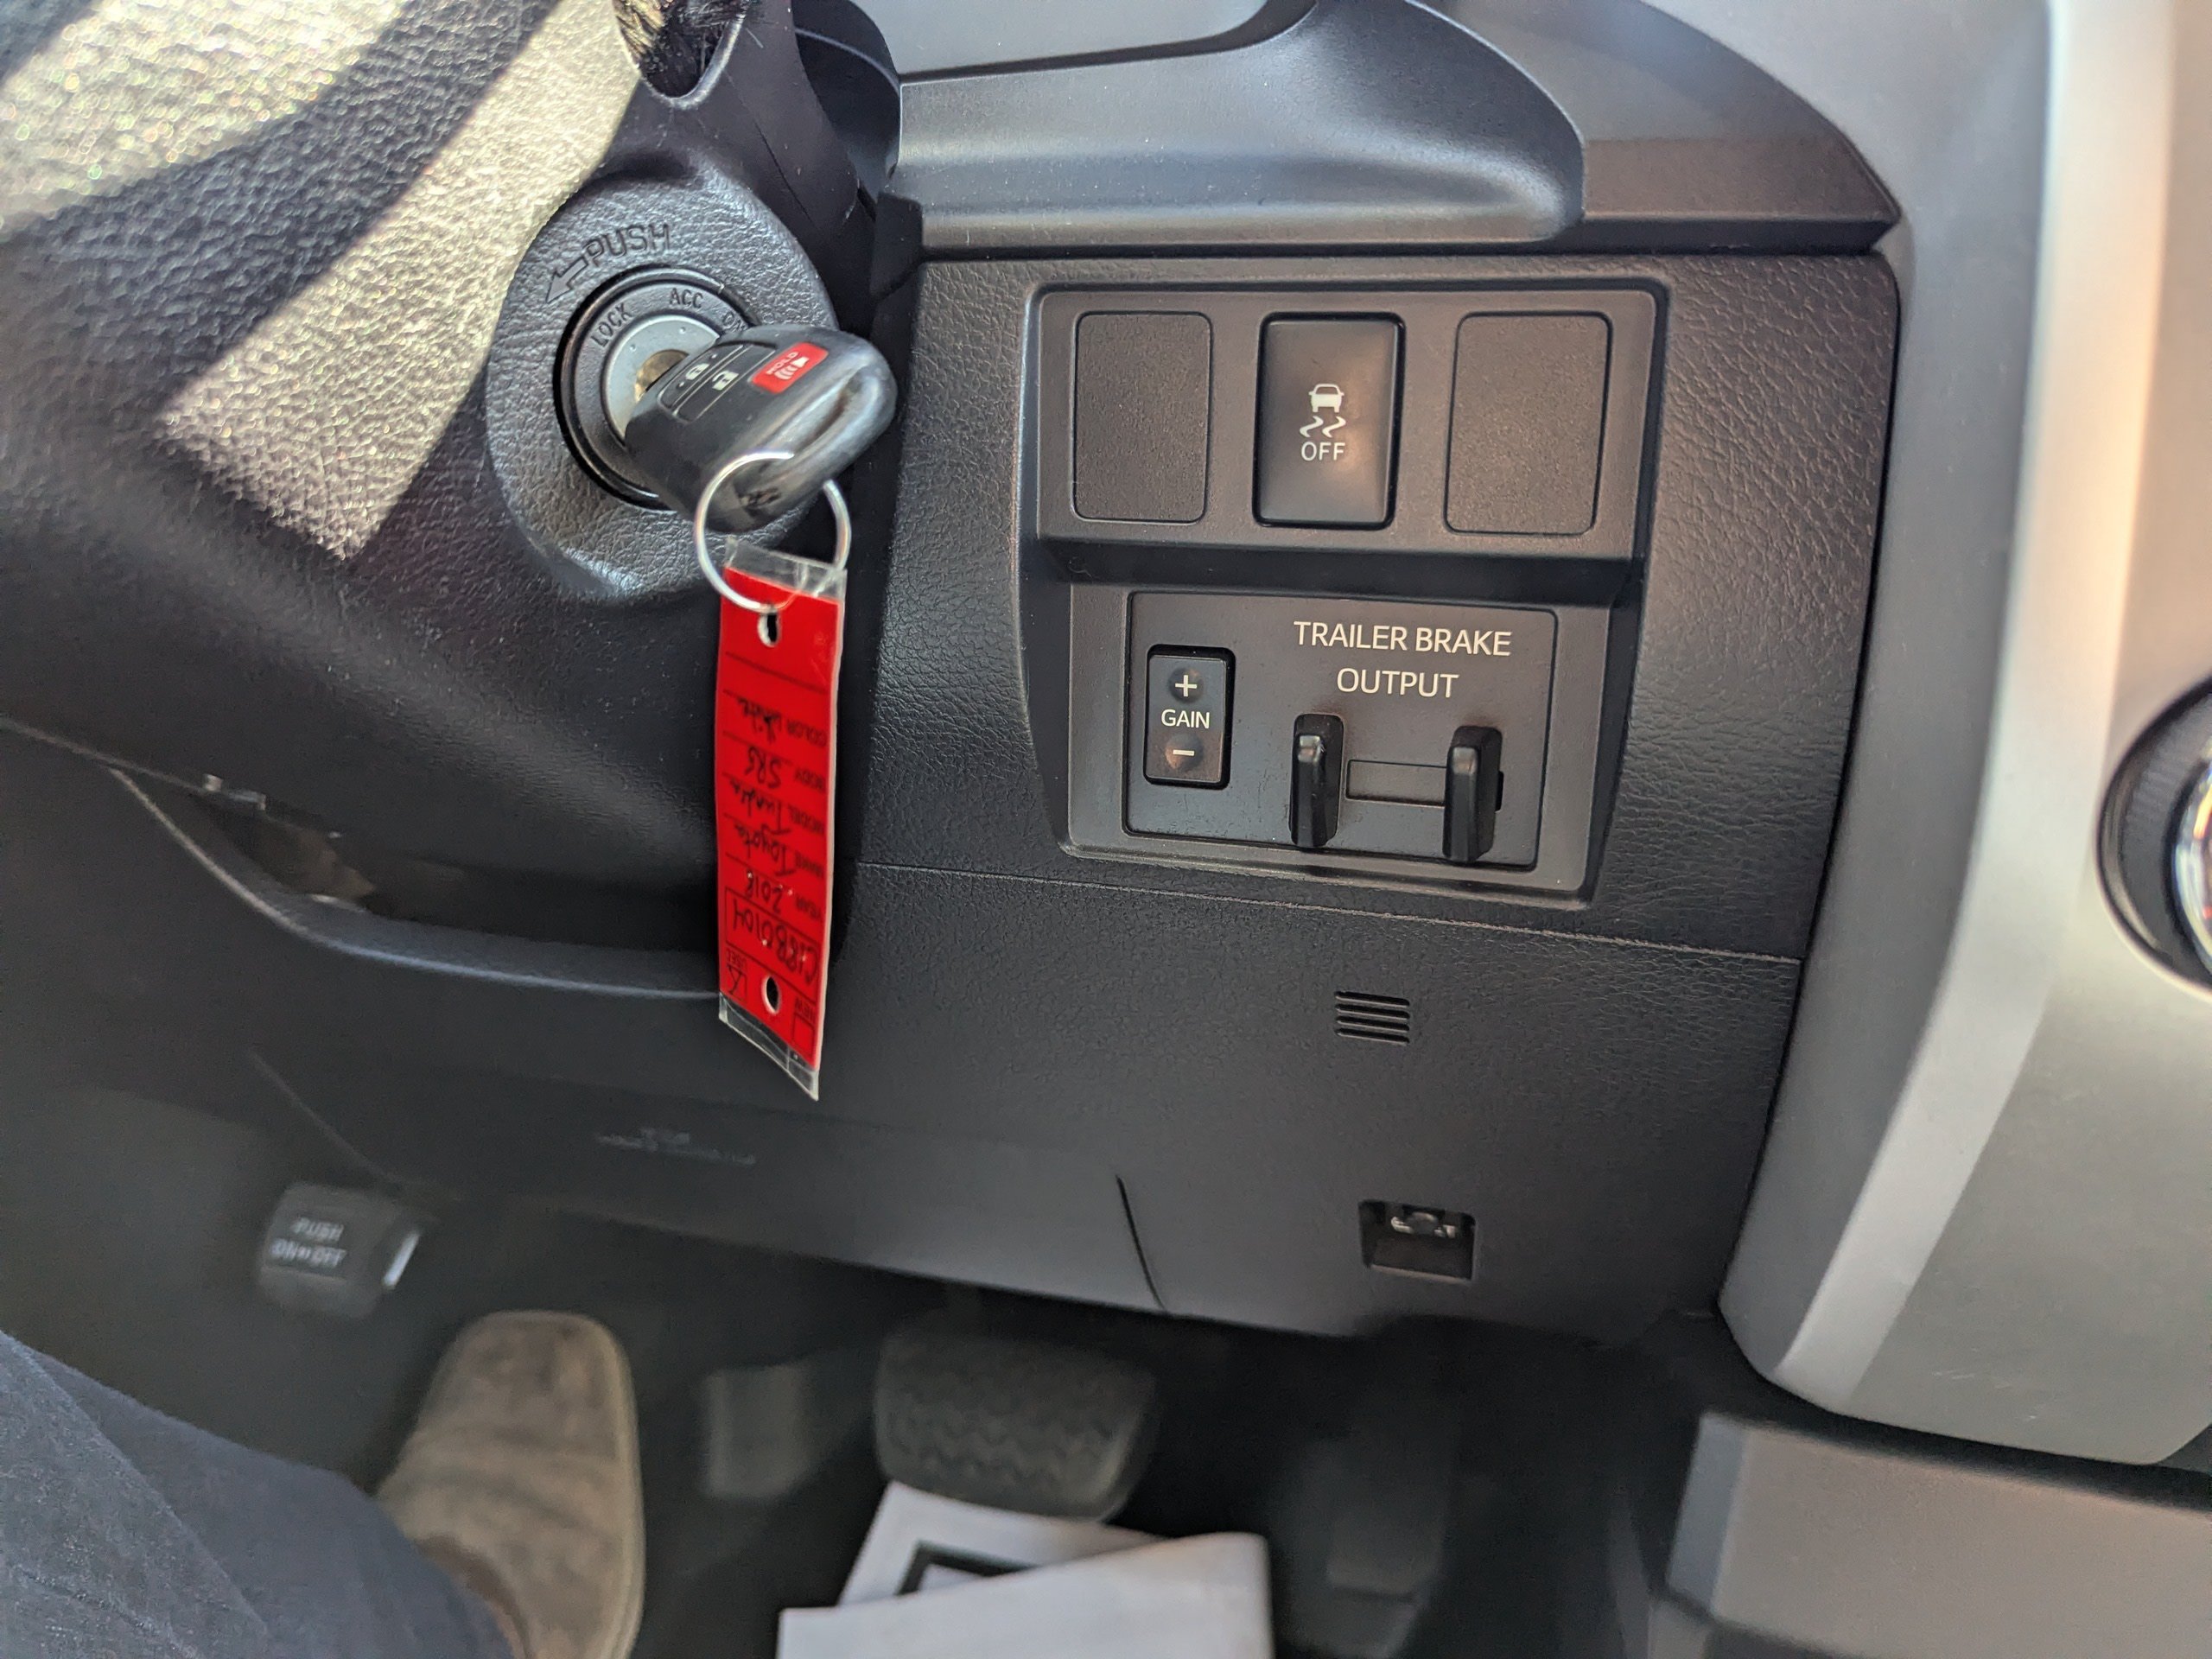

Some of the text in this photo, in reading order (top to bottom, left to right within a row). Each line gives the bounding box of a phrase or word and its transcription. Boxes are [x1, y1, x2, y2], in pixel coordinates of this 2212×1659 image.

[583, 224, 671, 266] PUSH
[670, 288, 703, 309] ACC
[590, 303, 632, 347] LOCK
[721, 310, 747, 334] ON
[766, 352, 800, 376] HOLD
[1300, 442, 1345, 461] OFF
[1294, 621, 1511, 656] TRAILER BRAKE
[1337, 668, 1459, 698] OUTPUT
[1161, 709, 1211, 729] GAIN
[291, 1217, 345, 1242] PUSH
